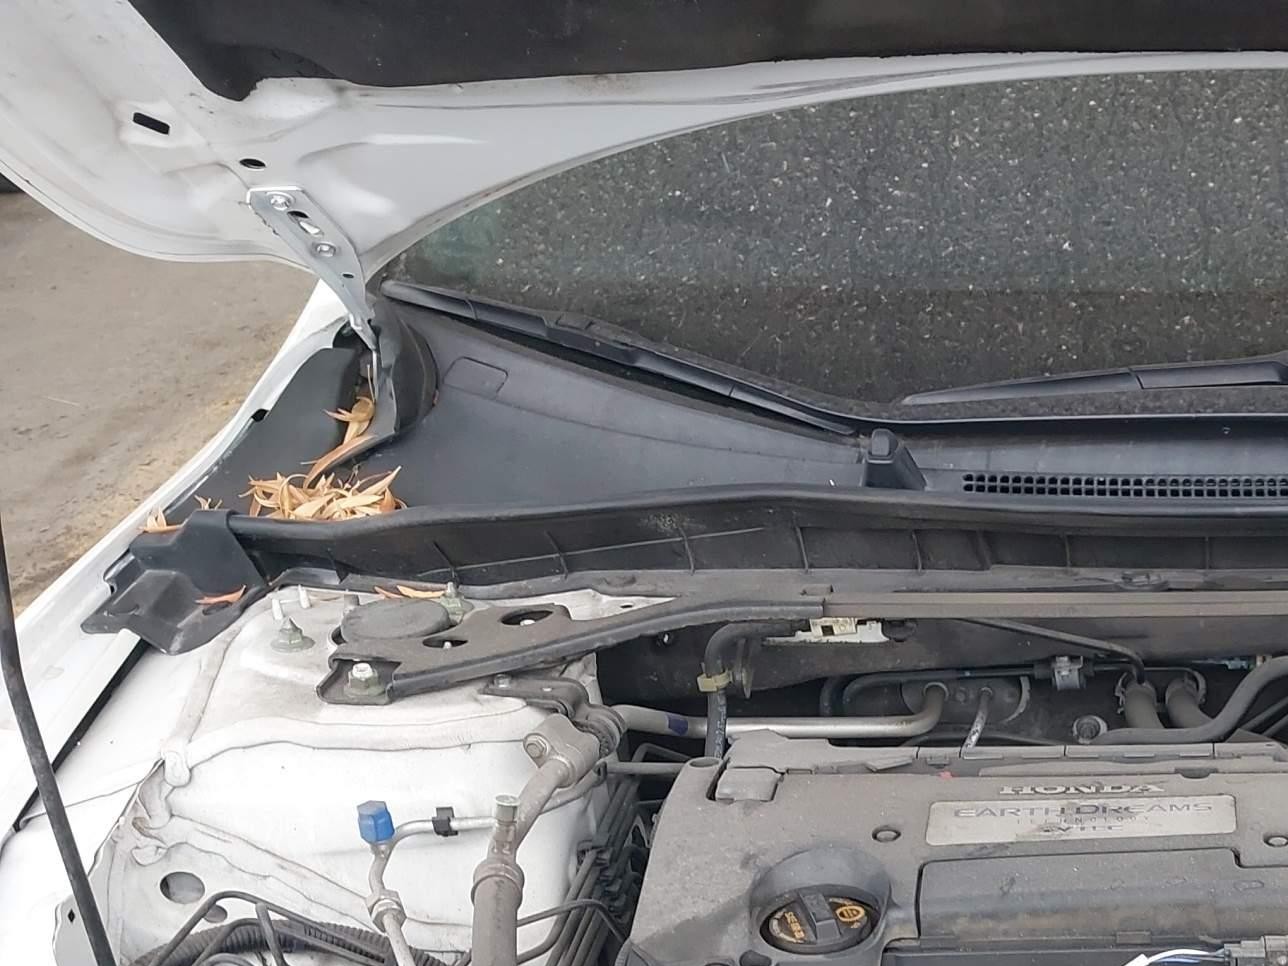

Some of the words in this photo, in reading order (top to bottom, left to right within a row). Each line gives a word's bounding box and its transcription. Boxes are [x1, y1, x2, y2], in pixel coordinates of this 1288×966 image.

[1000, 783, 1166, 795] HONDA
[953, 805, 1068, 818] EARTH
[1074, 802, 1213, 816] DREAMS
